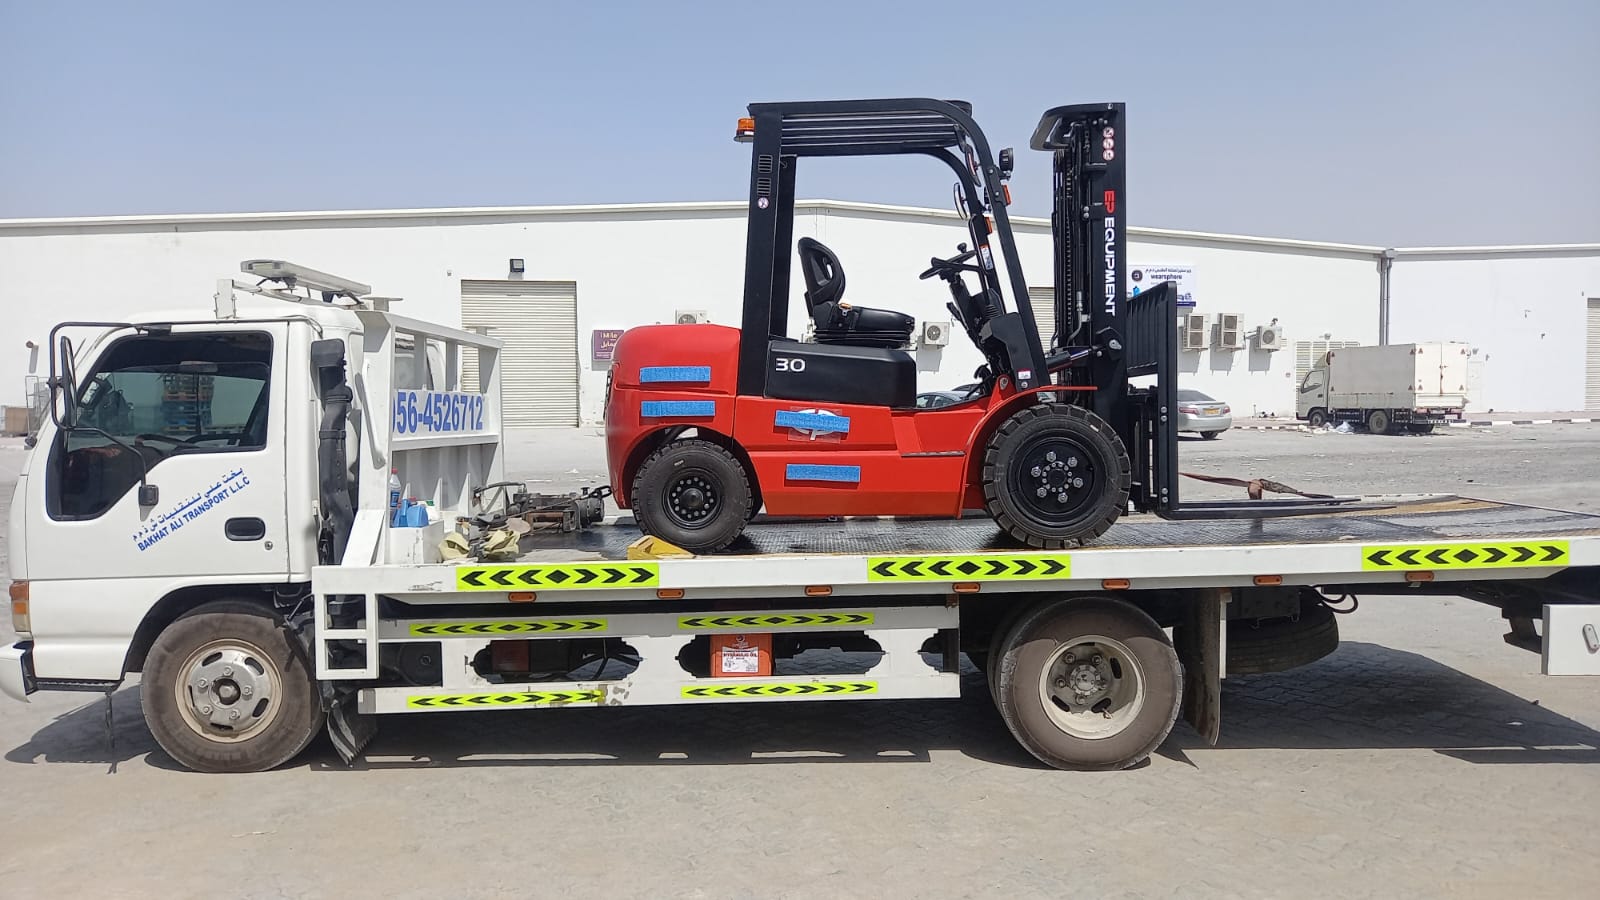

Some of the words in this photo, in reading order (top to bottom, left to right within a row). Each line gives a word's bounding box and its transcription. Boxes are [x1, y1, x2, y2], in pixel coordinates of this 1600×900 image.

[1104, 190, 1116, 214] EP
[1104, 216, 1116, 316] EQUIPMENT
[392, 391, 483, 434] 56-4526712
[137, 526, 170, 552] BAKHAT
[170, 518, 184, 532] ALI
[182, 488, 232, 522] TRANSPORT
[229, 476, 250, 494] L.L.C
